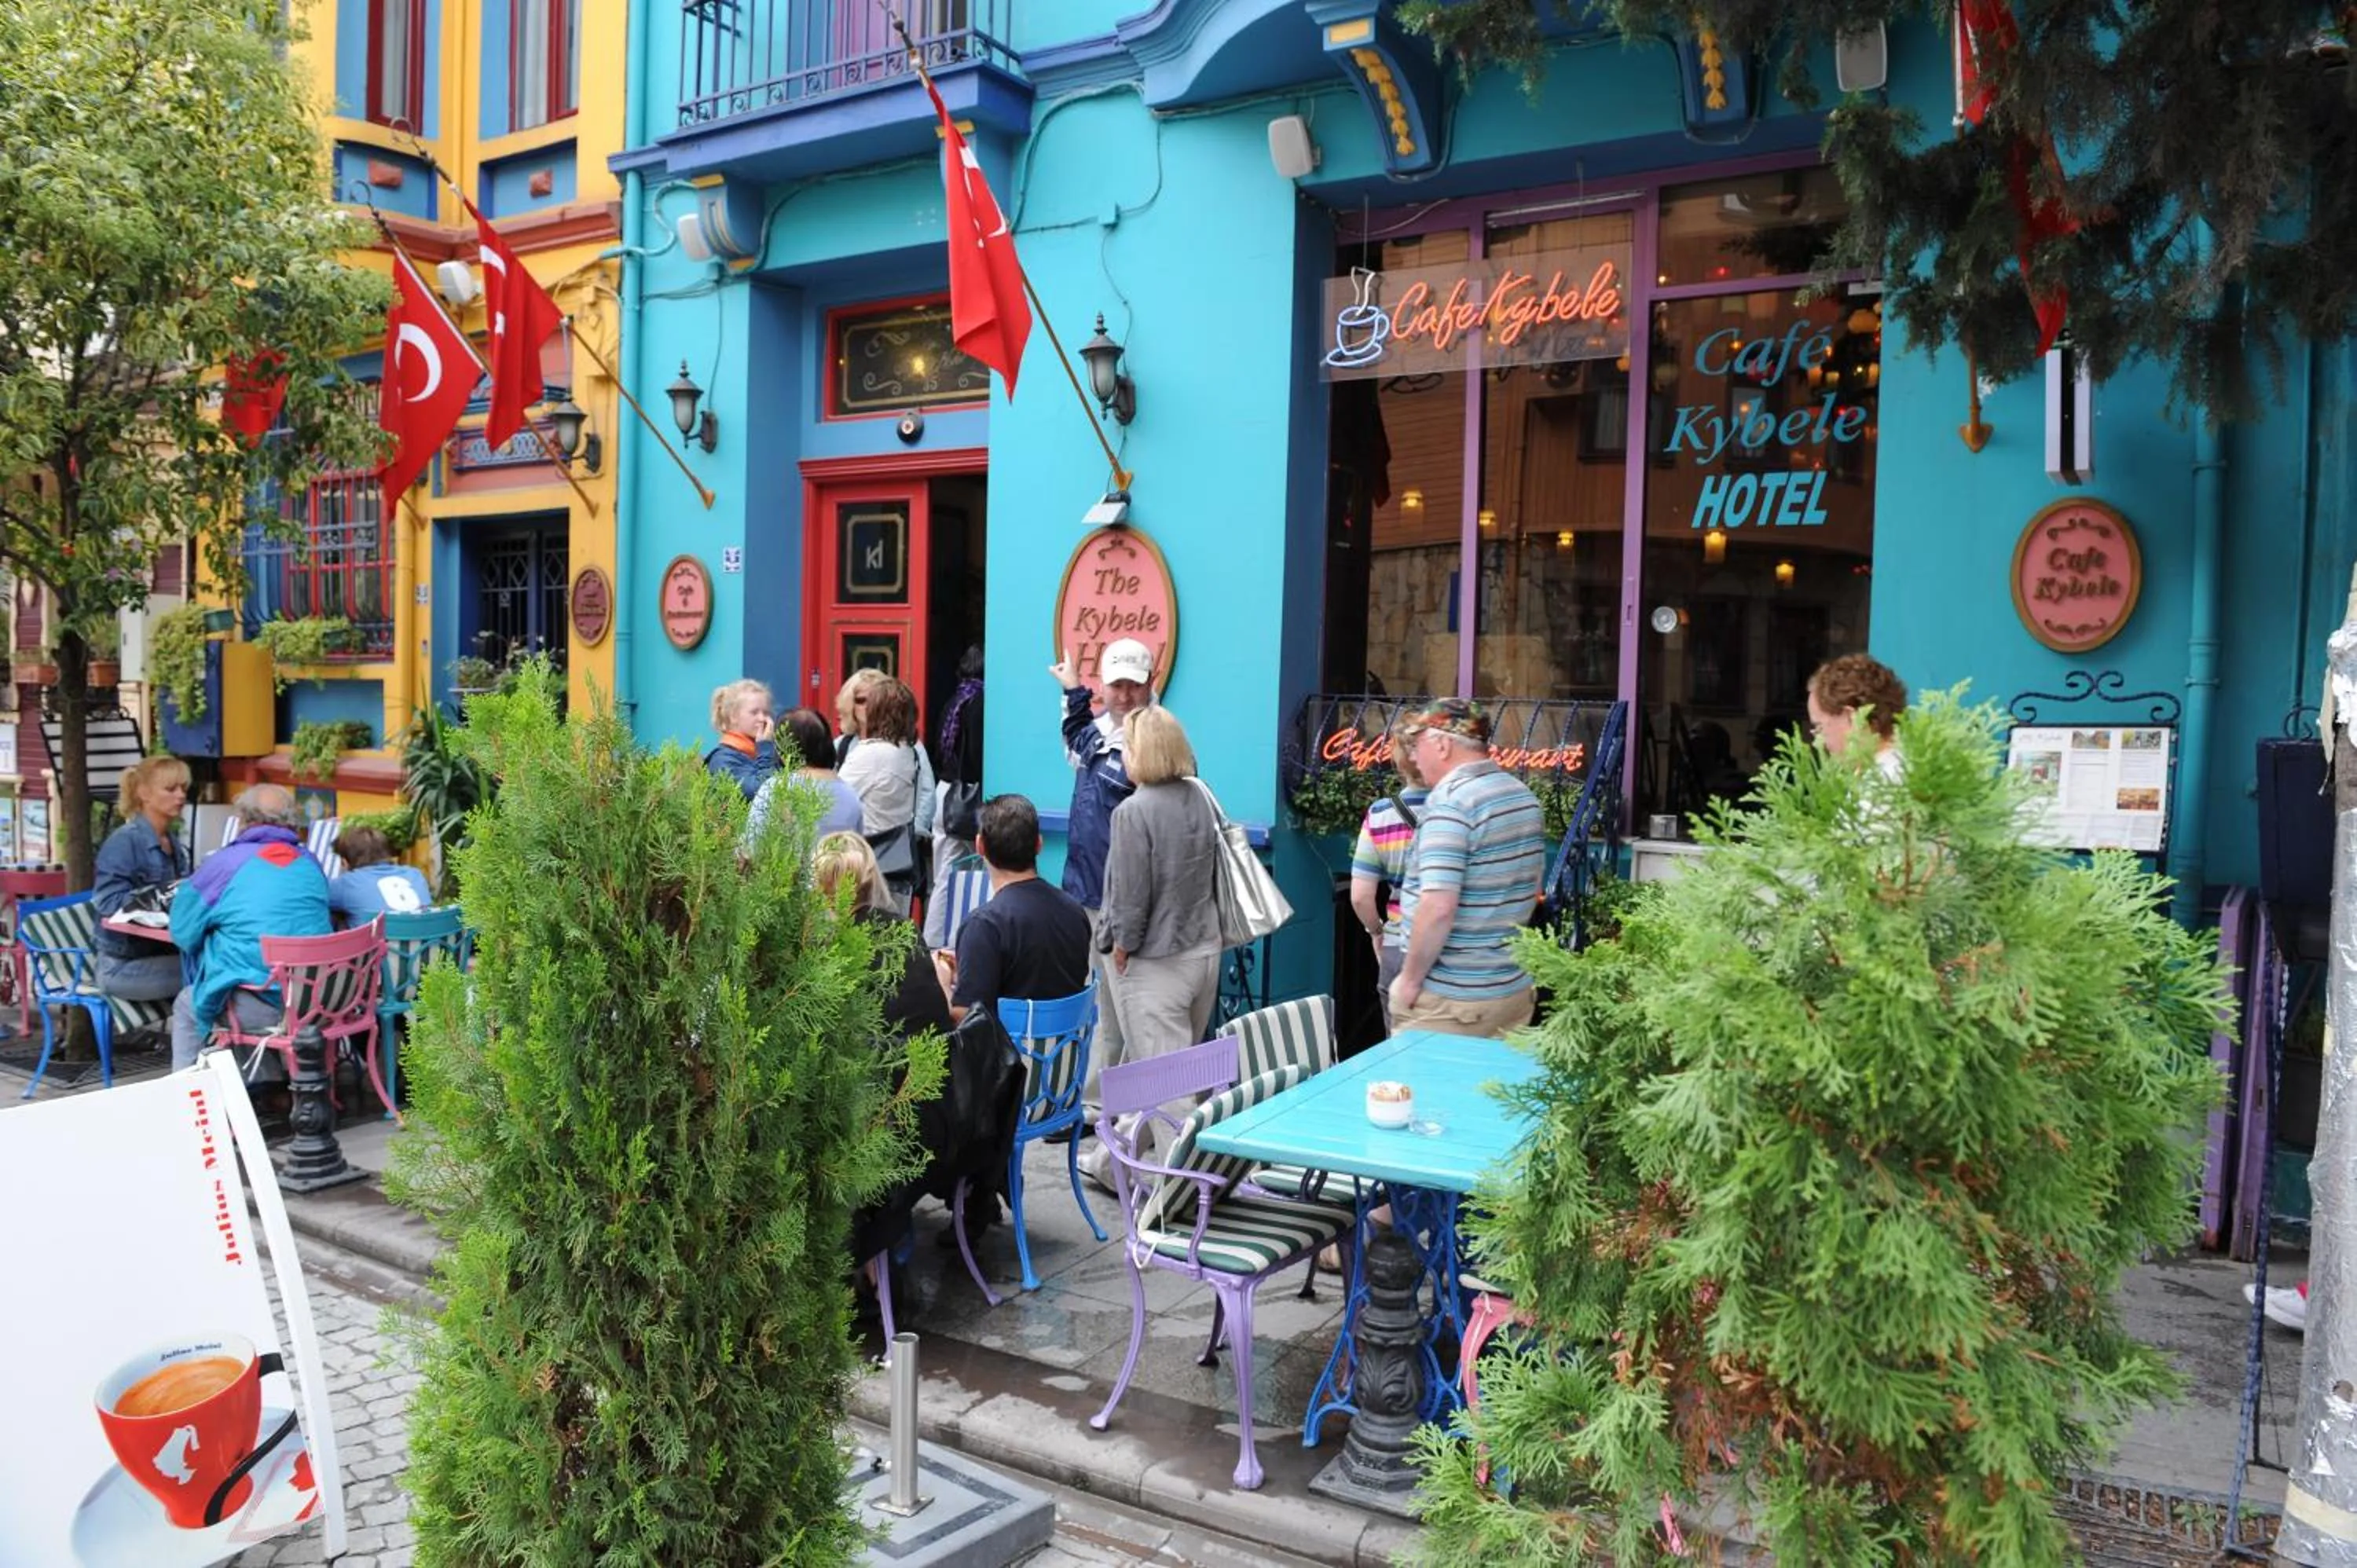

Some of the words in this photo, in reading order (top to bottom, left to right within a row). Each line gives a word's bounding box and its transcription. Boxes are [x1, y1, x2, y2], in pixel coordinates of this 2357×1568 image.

[1391, 277, 1475, 350] Cafe
[1479, 262, 1619, 346] Kybele
[1694, 319, 1833, 387] Café
[1662, 392, 1867, 465] Kybele
[1691, 471, 1829, 529] HOTEL
[1094, 567, 1141, 595] The
[2033, 574, 2122, 605] Kybele
[2047, 546, 2107, 574] Cafe
[1073, 605, 1160, 639] Kybele
[189, 1090, 219, 1170] Meinl
[215, 1179, 243, 1266] Julius
